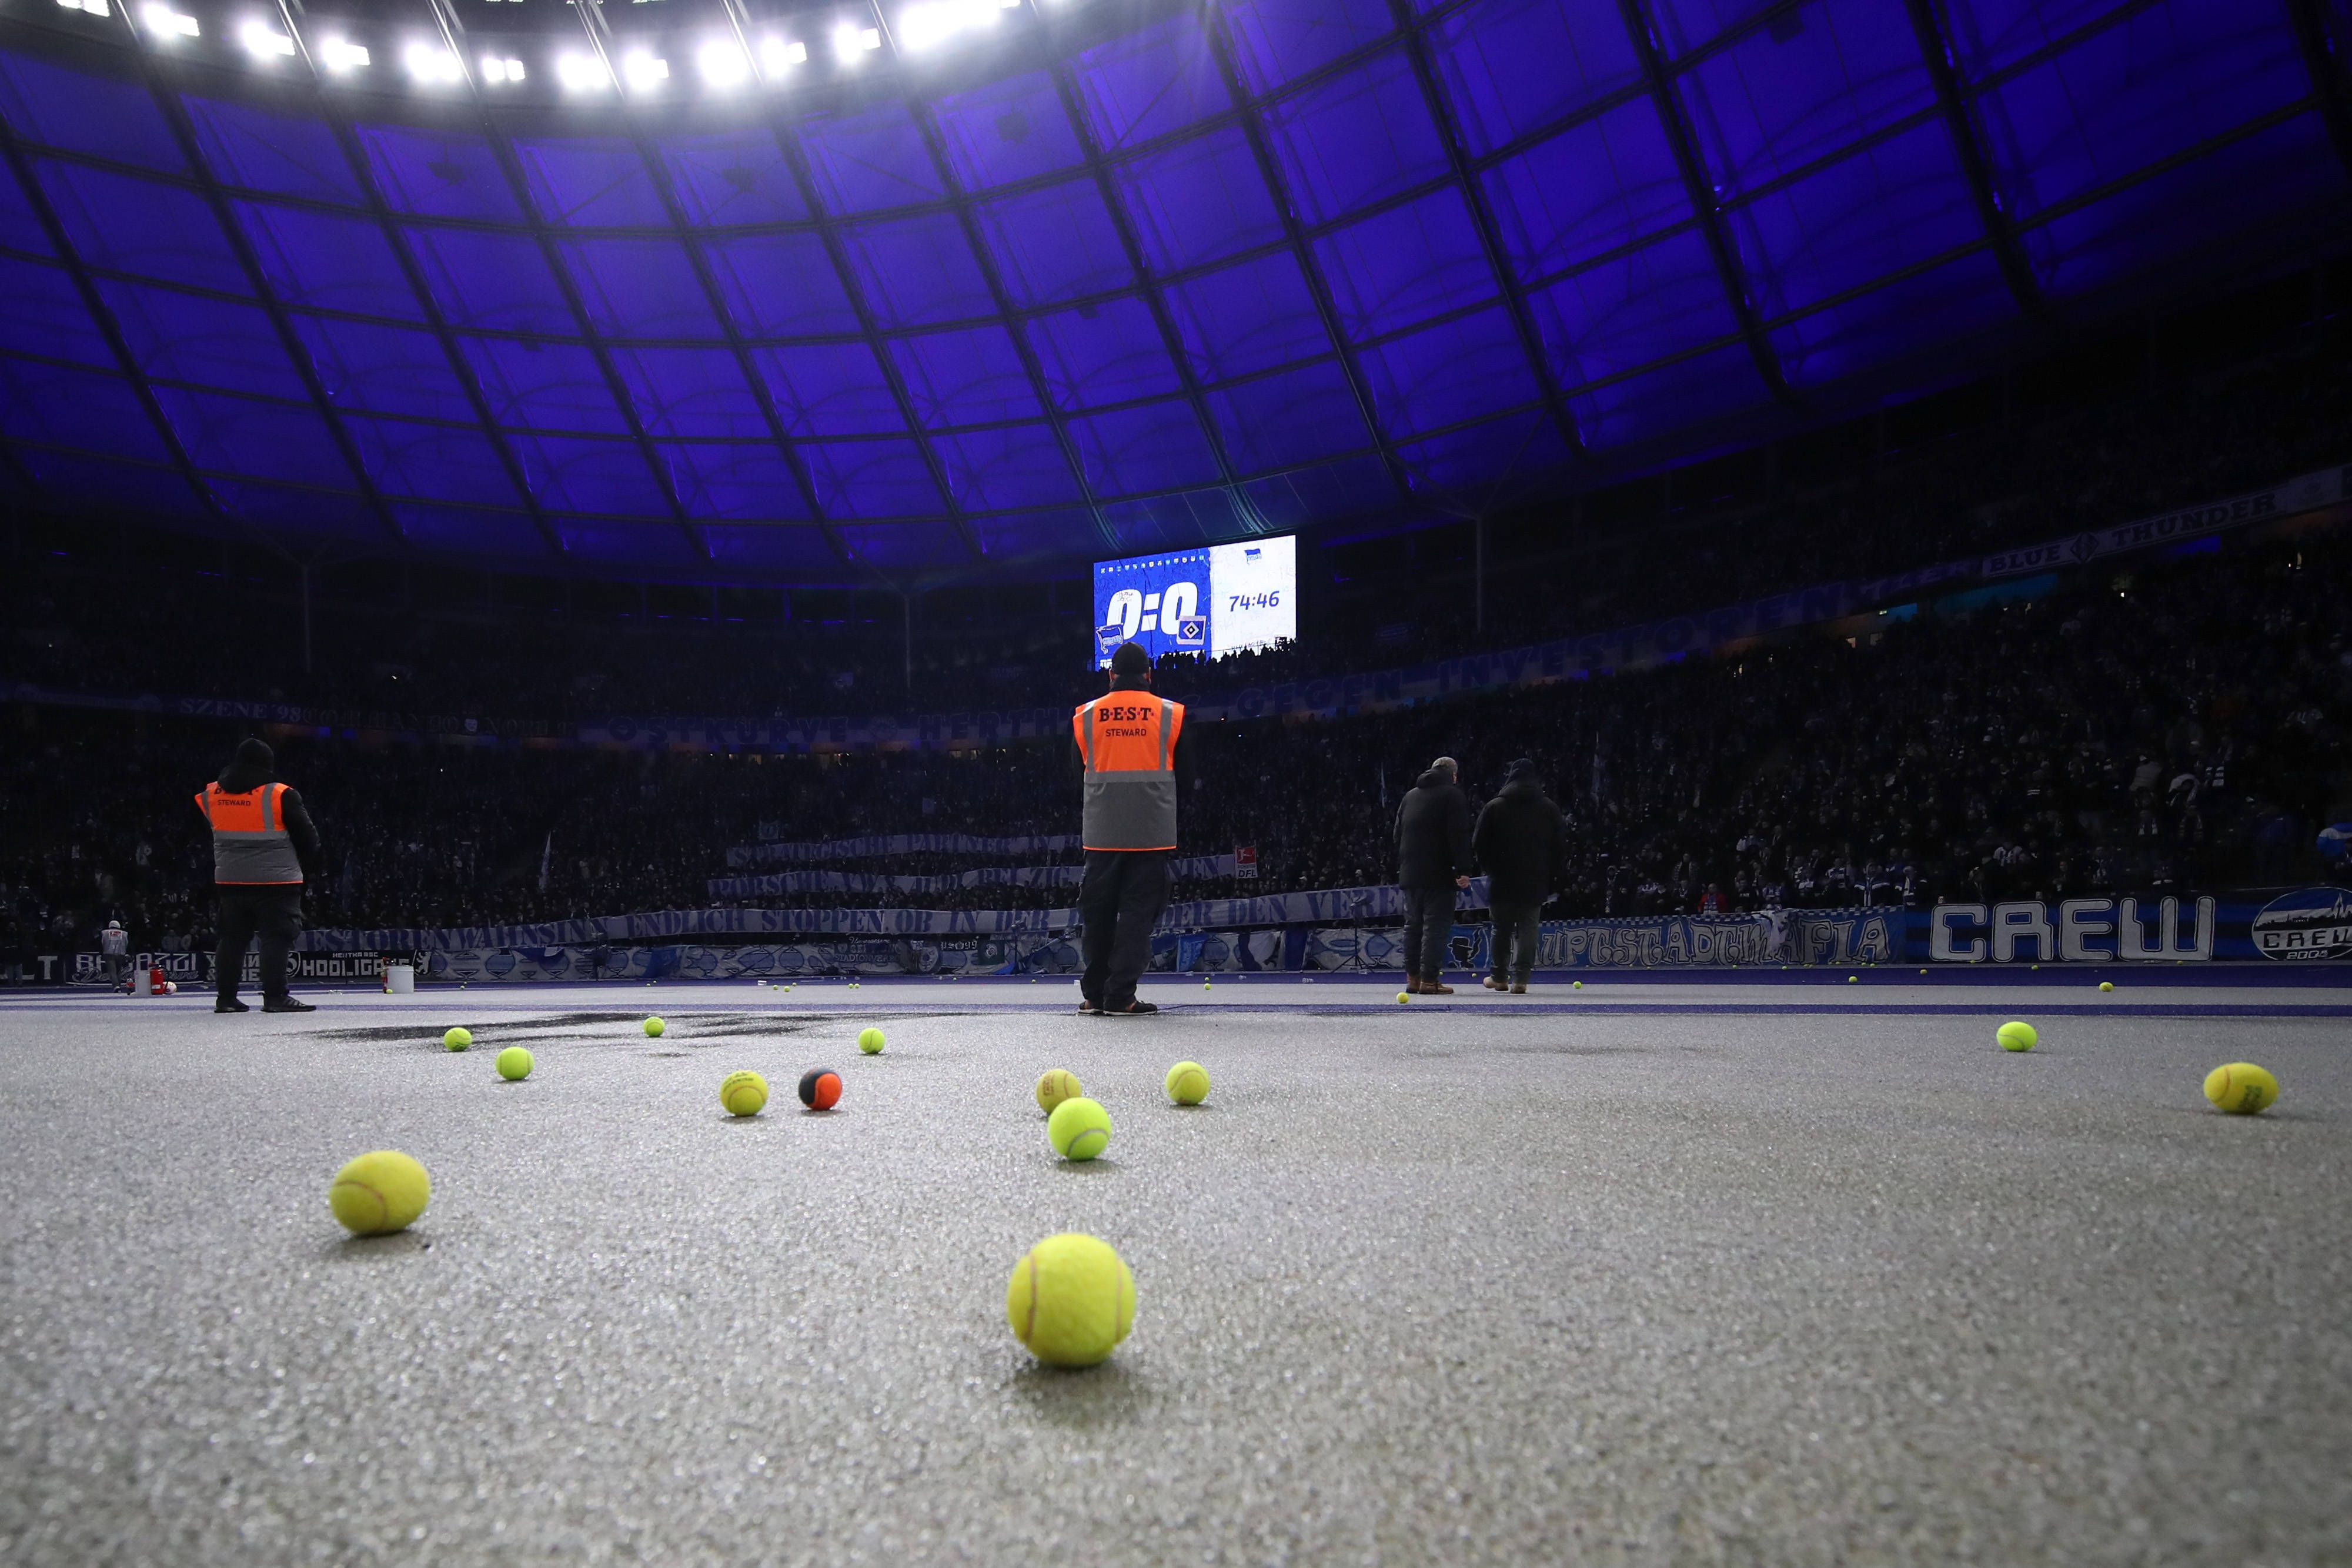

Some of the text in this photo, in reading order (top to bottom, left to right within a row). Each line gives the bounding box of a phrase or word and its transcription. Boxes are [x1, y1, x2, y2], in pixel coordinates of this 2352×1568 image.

[1990, 492, 2276, 573] BLUE THUNDER
[1107, 582, 1198, 639] 0:0
[1230, 590, 1279, 612] 74:46
[1237, 581, 1847, 717] GEGEN INVESTOREN
[179, 698, 267, 719] SZENE
[607, 708, 1073, 744] OSTKURVE HERTH
[1105, 728, 1147, 737] STEWARD
[306, 917, 608, 951] ESTORENWAHNSINN
[626, 911, 746, 936] ENDLICH
[895, 911, 933, 932] OB
[948, 911, 981, 932] IN
[1155, 900, 1213, 928] DER
[1227, 894, 1287, 925] DEN
